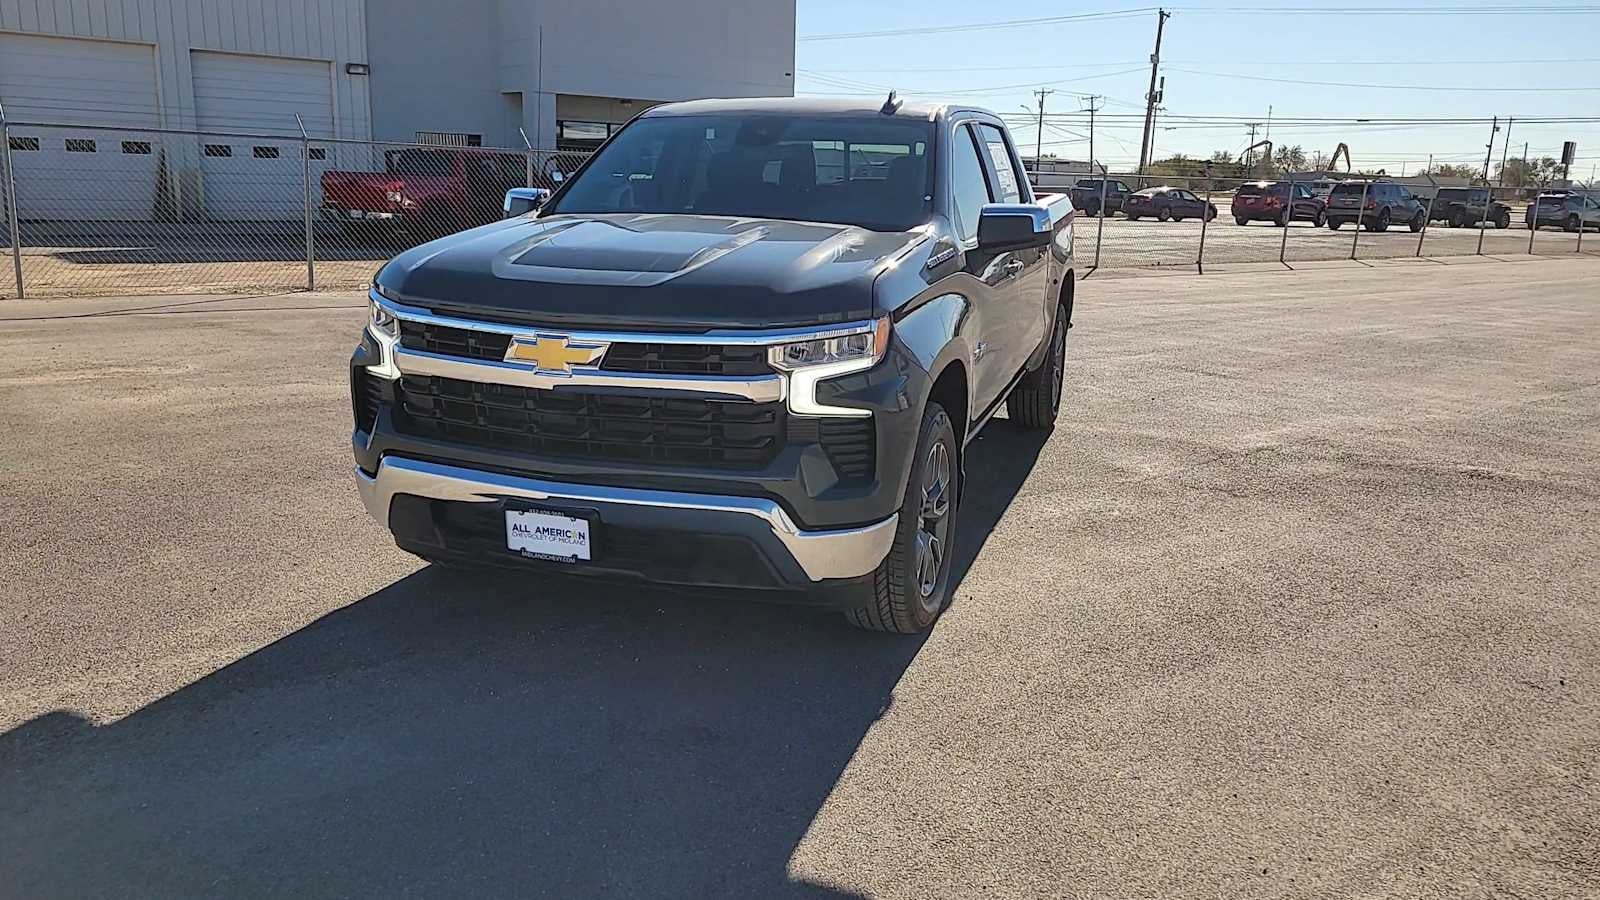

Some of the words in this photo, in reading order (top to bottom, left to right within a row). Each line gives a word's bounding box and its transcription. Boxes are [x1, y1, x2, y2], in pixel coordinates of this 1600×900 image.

[512, 523, 531, 533] ALL
[512, 531, 547, 541] CHEVROLET
[558, 537, 586, 546] MIDLAND
